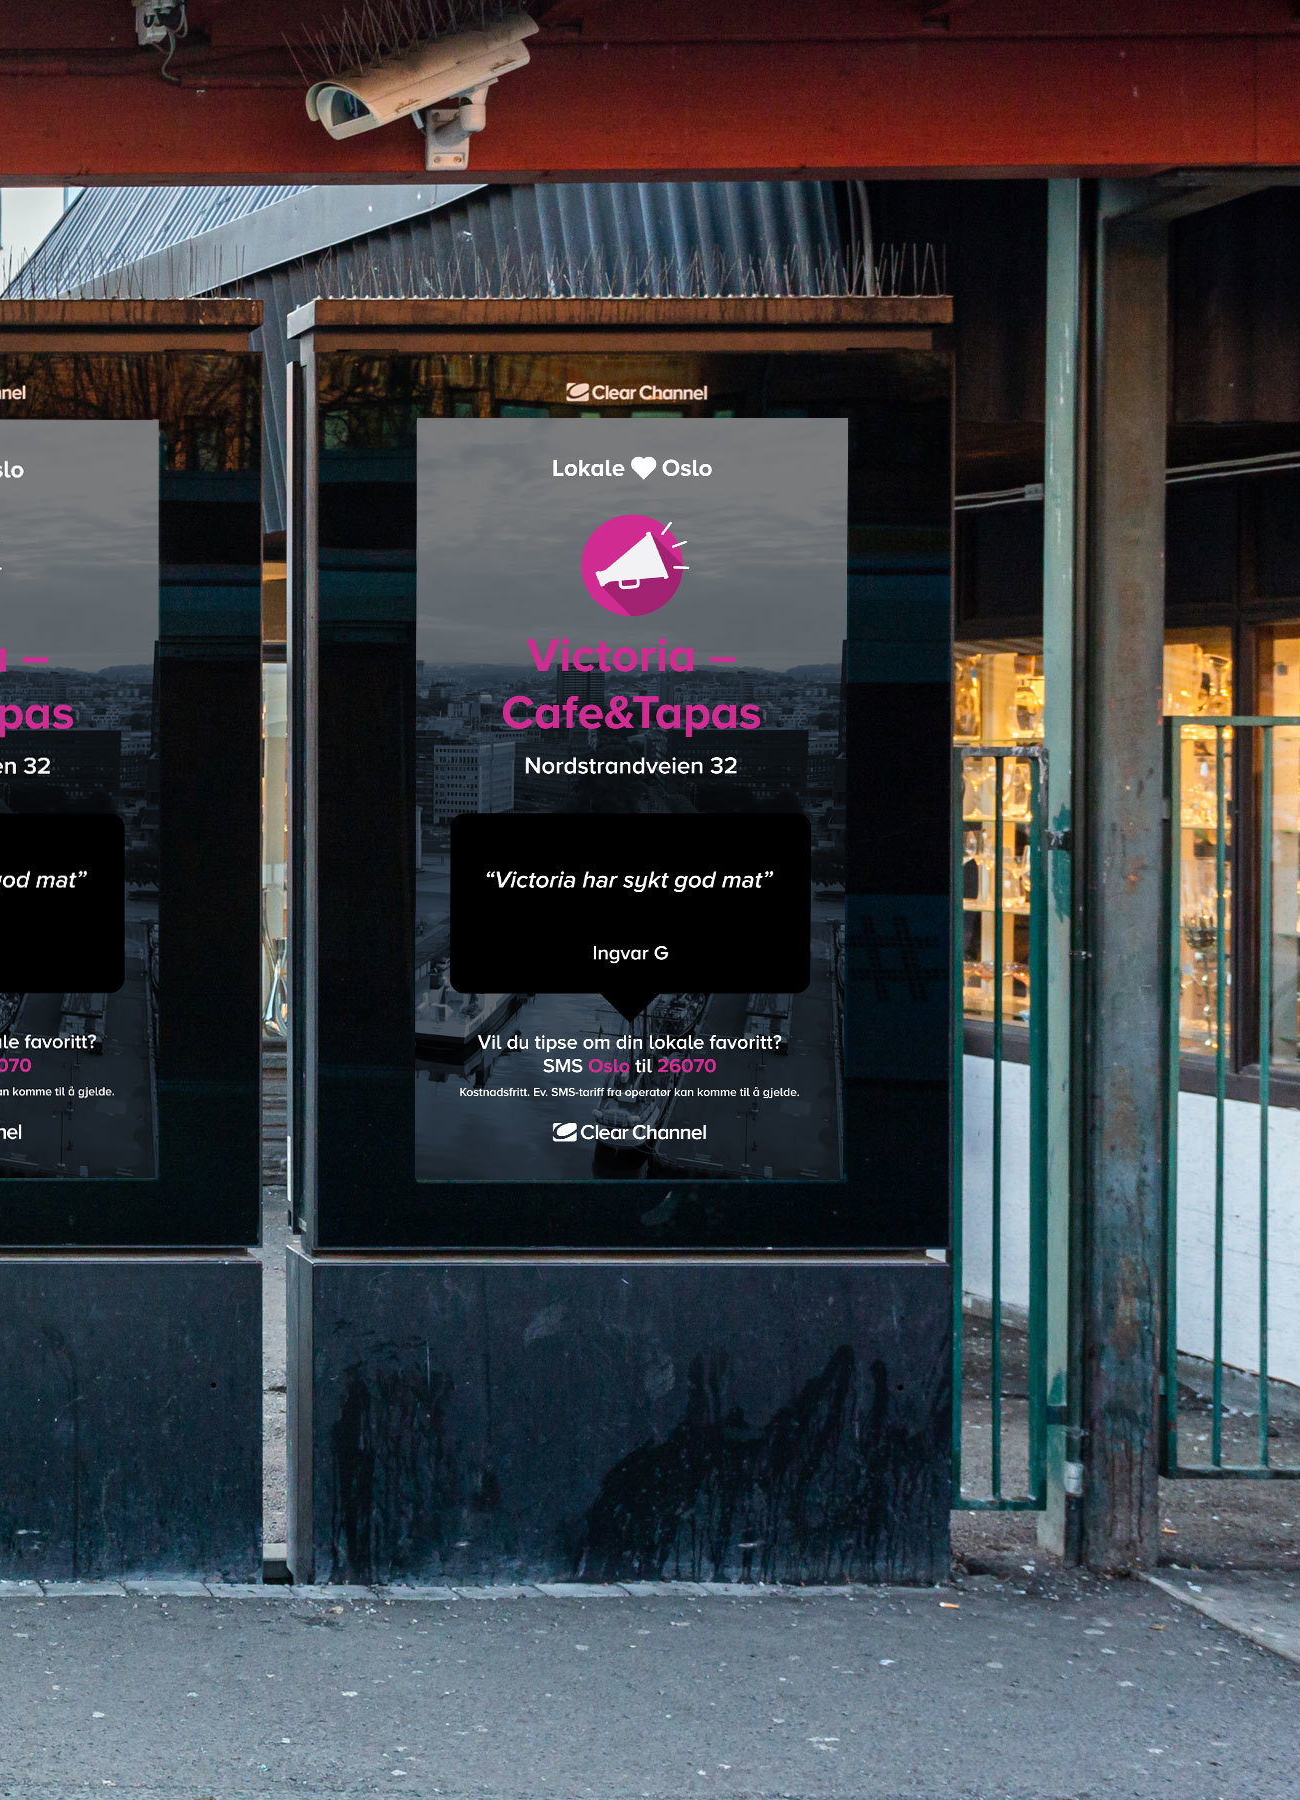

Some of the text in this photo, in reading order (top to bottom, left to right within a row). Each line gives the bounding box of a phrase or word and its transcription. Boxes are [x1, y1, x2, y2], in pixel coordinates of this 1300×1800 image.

[591, 384, 708, 401] Clear Channel
[552, 459, 713, 478] Lokale Oslo
[526, 637, 695, 673] Victoria
[502, 695, 761, 738] Cafe&Tapas
[23, 757, 51, 775] 32
[525, 756, 737, 775] Nordstrandveien 32
[582, 870, 619, 889] har
[622, 870, 670, 893] sykt
[673, 870, 717, 893] god
[593, 945, 669, 964] Ingvar G
[24, 1034, 97, 1049] favoritt?
[477, 1034, 782, 1053] Vil du tipse om din lokale favoritt?
[543, 1058, 717, 1074] SMS Oslo til 26070
[12, 1086, 53, 1097] komme
[54, 1086, 65, 1097] til
[78, 1086, 115, 1099] gjelde.
[459, 1087, 530, 1097] Kostnadsfritt.
[533, 1087, 548, 1097] Ev.
[551, 1087, 605, 1097] SMS-tariff
[606, 1087, 622, 1097] fra
[624, 1088, 672, 1099] operatør
[674, 1087, 694, 1097] kan
[697, 1087, 737, 1097] komme
[739, 1087, 751, 1097] til
[762, 1087, 800, 1099] gjelde.
[580, 1124, 707, 1140] Clear Channel
